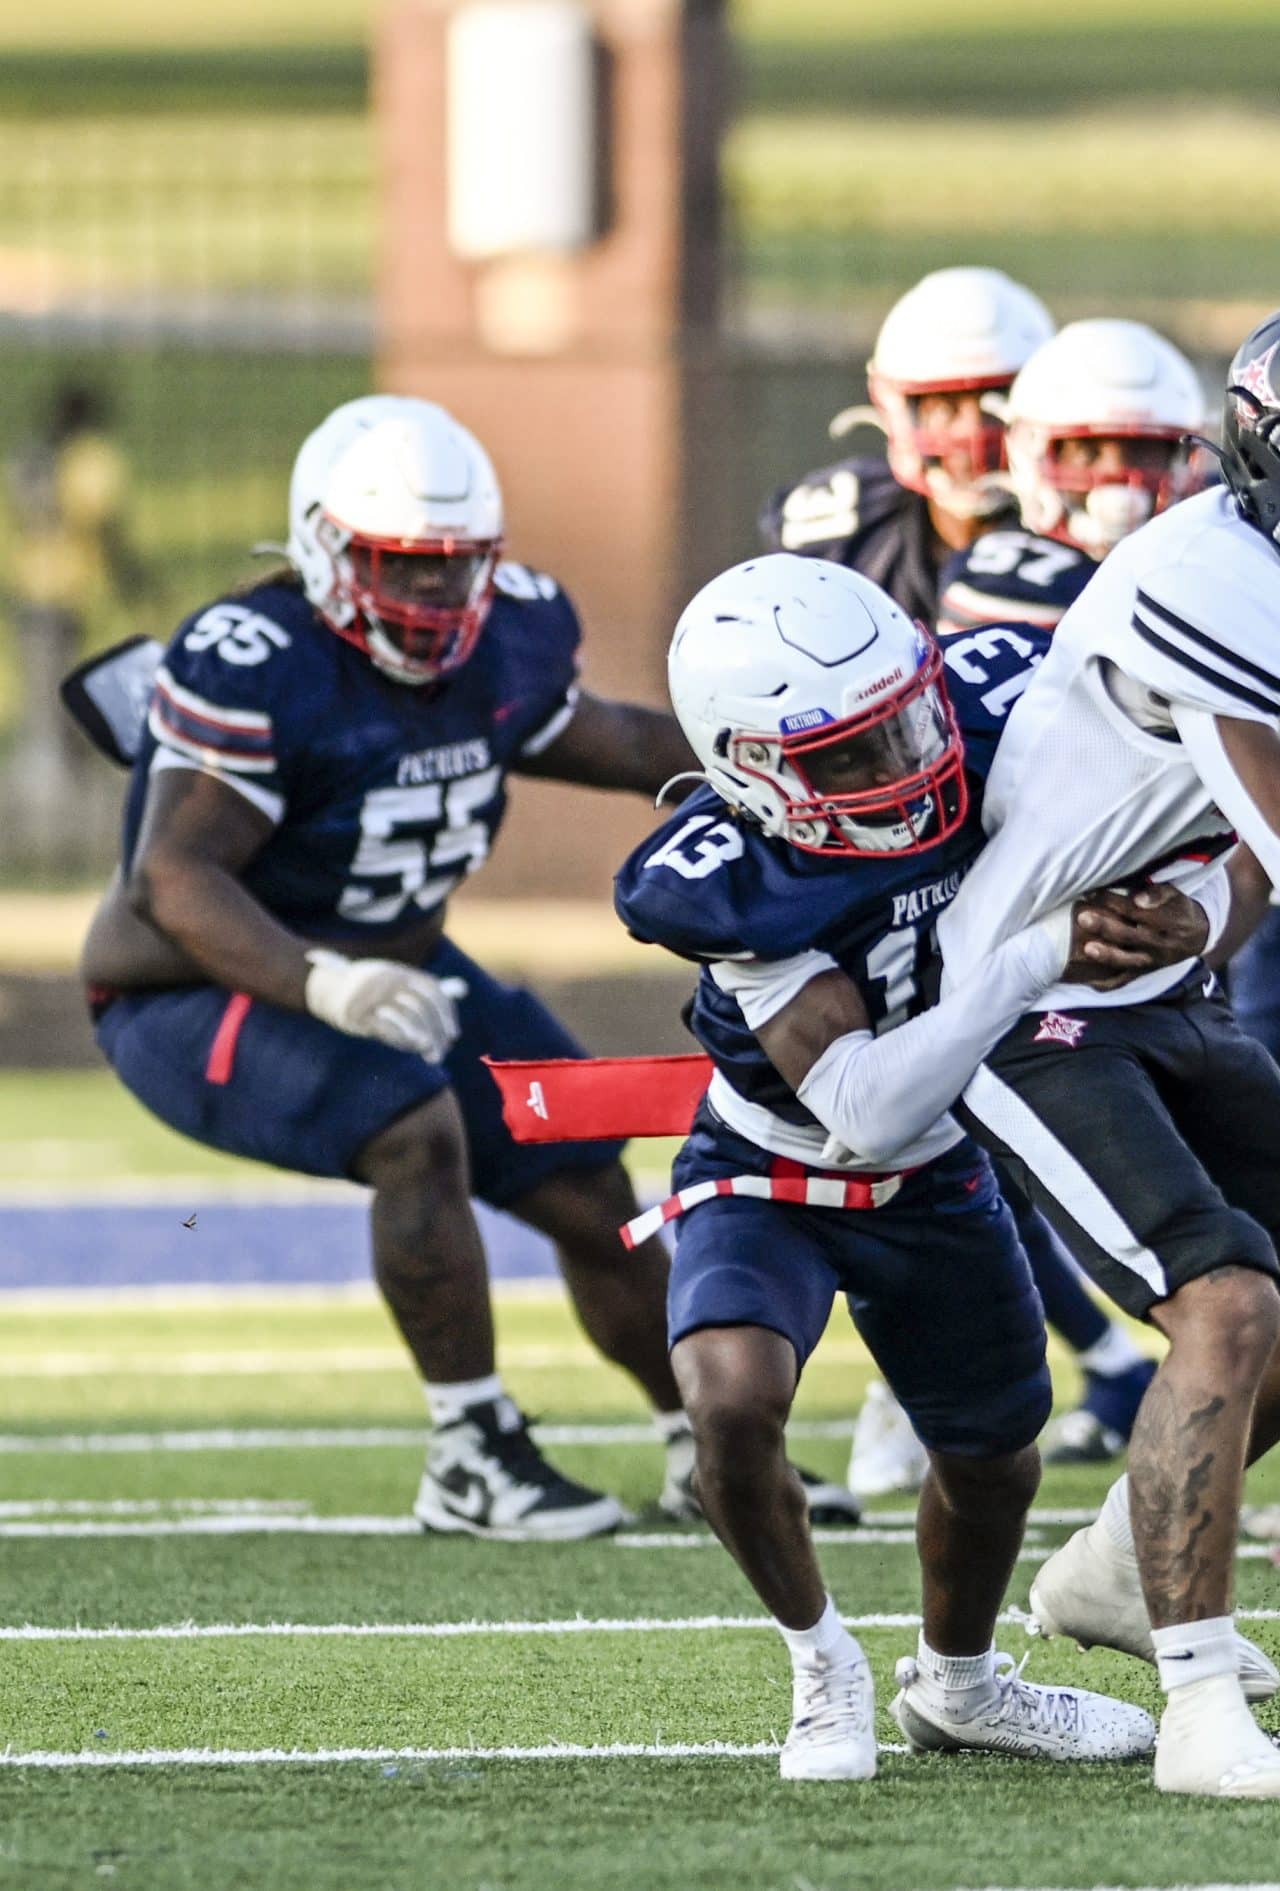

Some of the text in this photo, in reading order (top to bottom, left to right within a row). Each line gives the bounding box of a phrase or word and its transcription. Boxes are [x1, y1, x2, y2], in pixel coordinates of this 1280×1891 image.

[967, 531, 1081, 586] 57
[184, 604, 292, 666] 55
[337, 765, 501, 923] 55
[643, 815, 744, 879] 13
[892, 864, 968, 926] PATRIO
[866, 926, 943, 1037] 1
